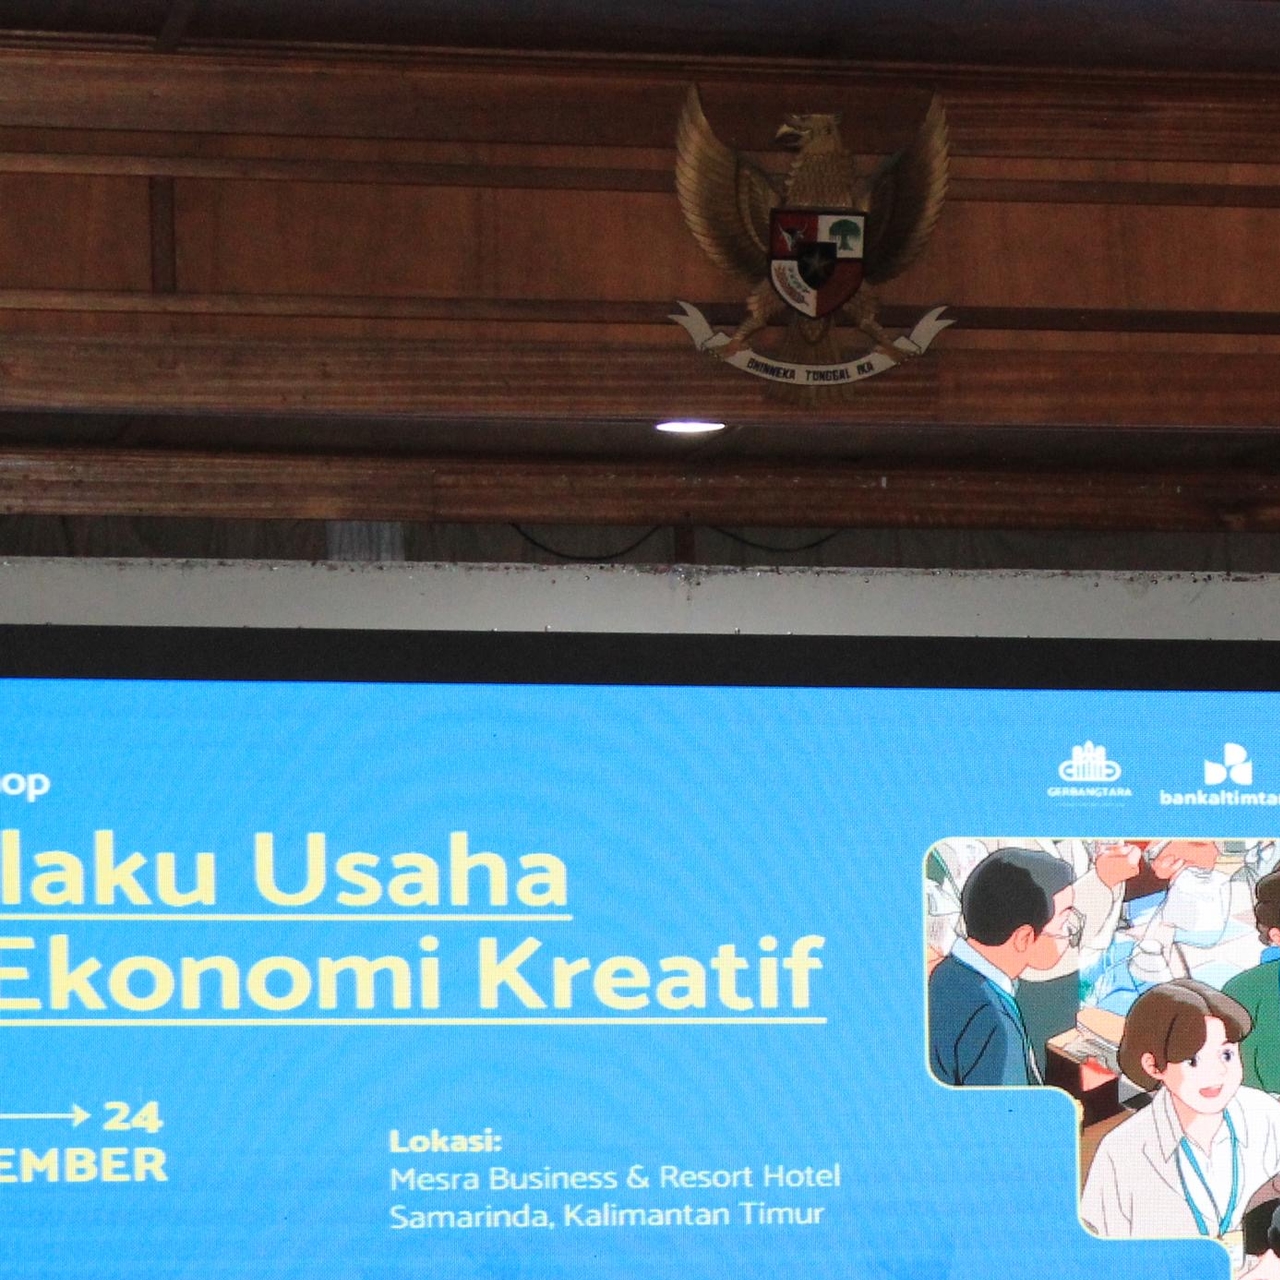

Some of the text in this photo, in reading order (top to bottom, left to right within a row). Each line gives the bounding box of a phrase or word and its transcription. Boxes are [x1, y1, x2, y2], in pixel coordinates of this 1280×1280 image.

[1, 828, 568, 907] laku Usaha
[0, 934, 826, 1011] Ekonomi Kreatif
[103, 1100, 164, 1133] 24
[389, 1129, 502, 1154] Lokasi:
[390, 1163, 841, 1190] Mesra Business & Resort Hotel
[390, 1202, 823, 1229] Samarinda, Kalimantan Timur
